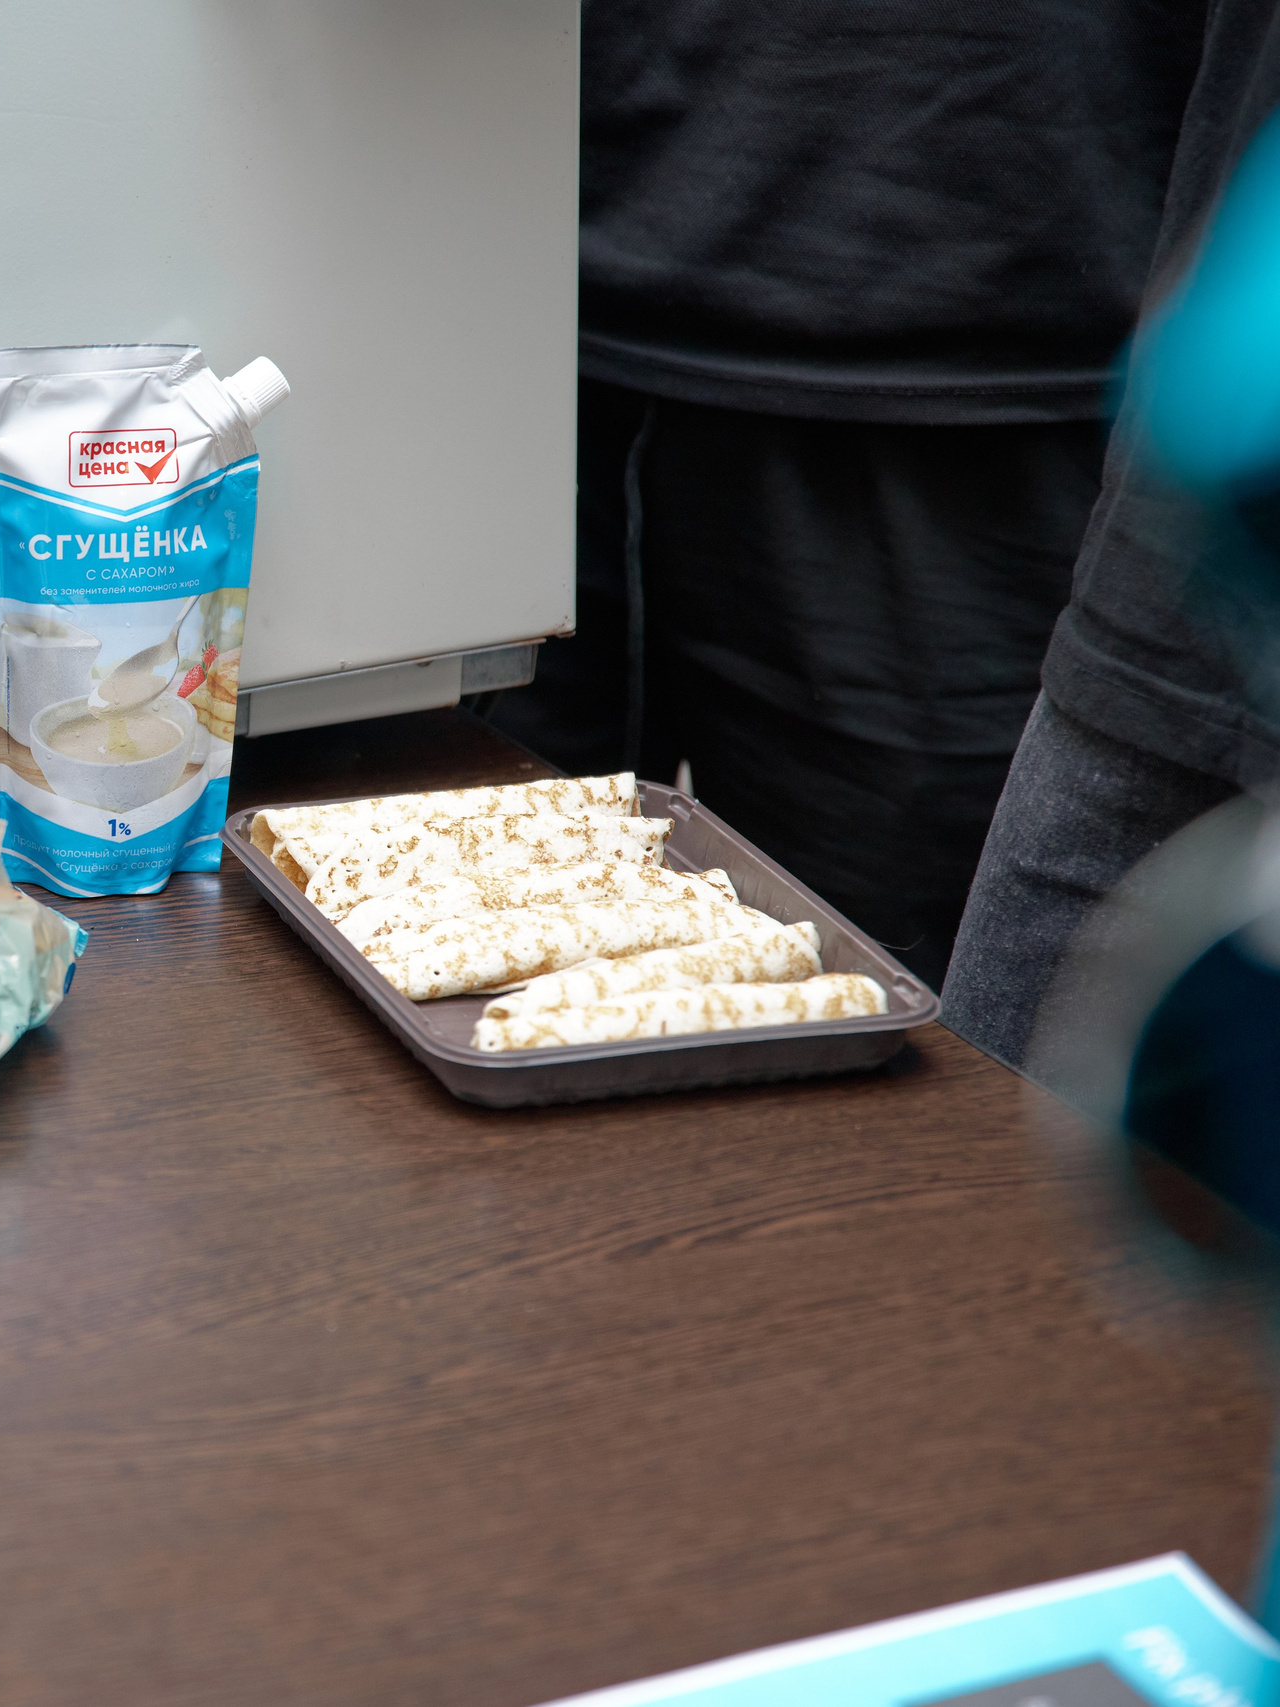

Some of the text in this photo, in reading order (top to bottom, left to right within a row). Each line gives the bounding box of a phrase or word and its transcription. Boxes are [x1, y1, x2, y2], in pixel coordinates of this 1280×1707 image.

[80, 440, 166, 460] красная
[79, 461, 130, 479] цена
[86, 569, 96, 581] С
[40, 578, 200, 597] без заменителей молочного жира
[107, 818, 132, 837] 1%
[12, 834, 50, 854] Продукт
[52, 847, 109, 859] молочный
